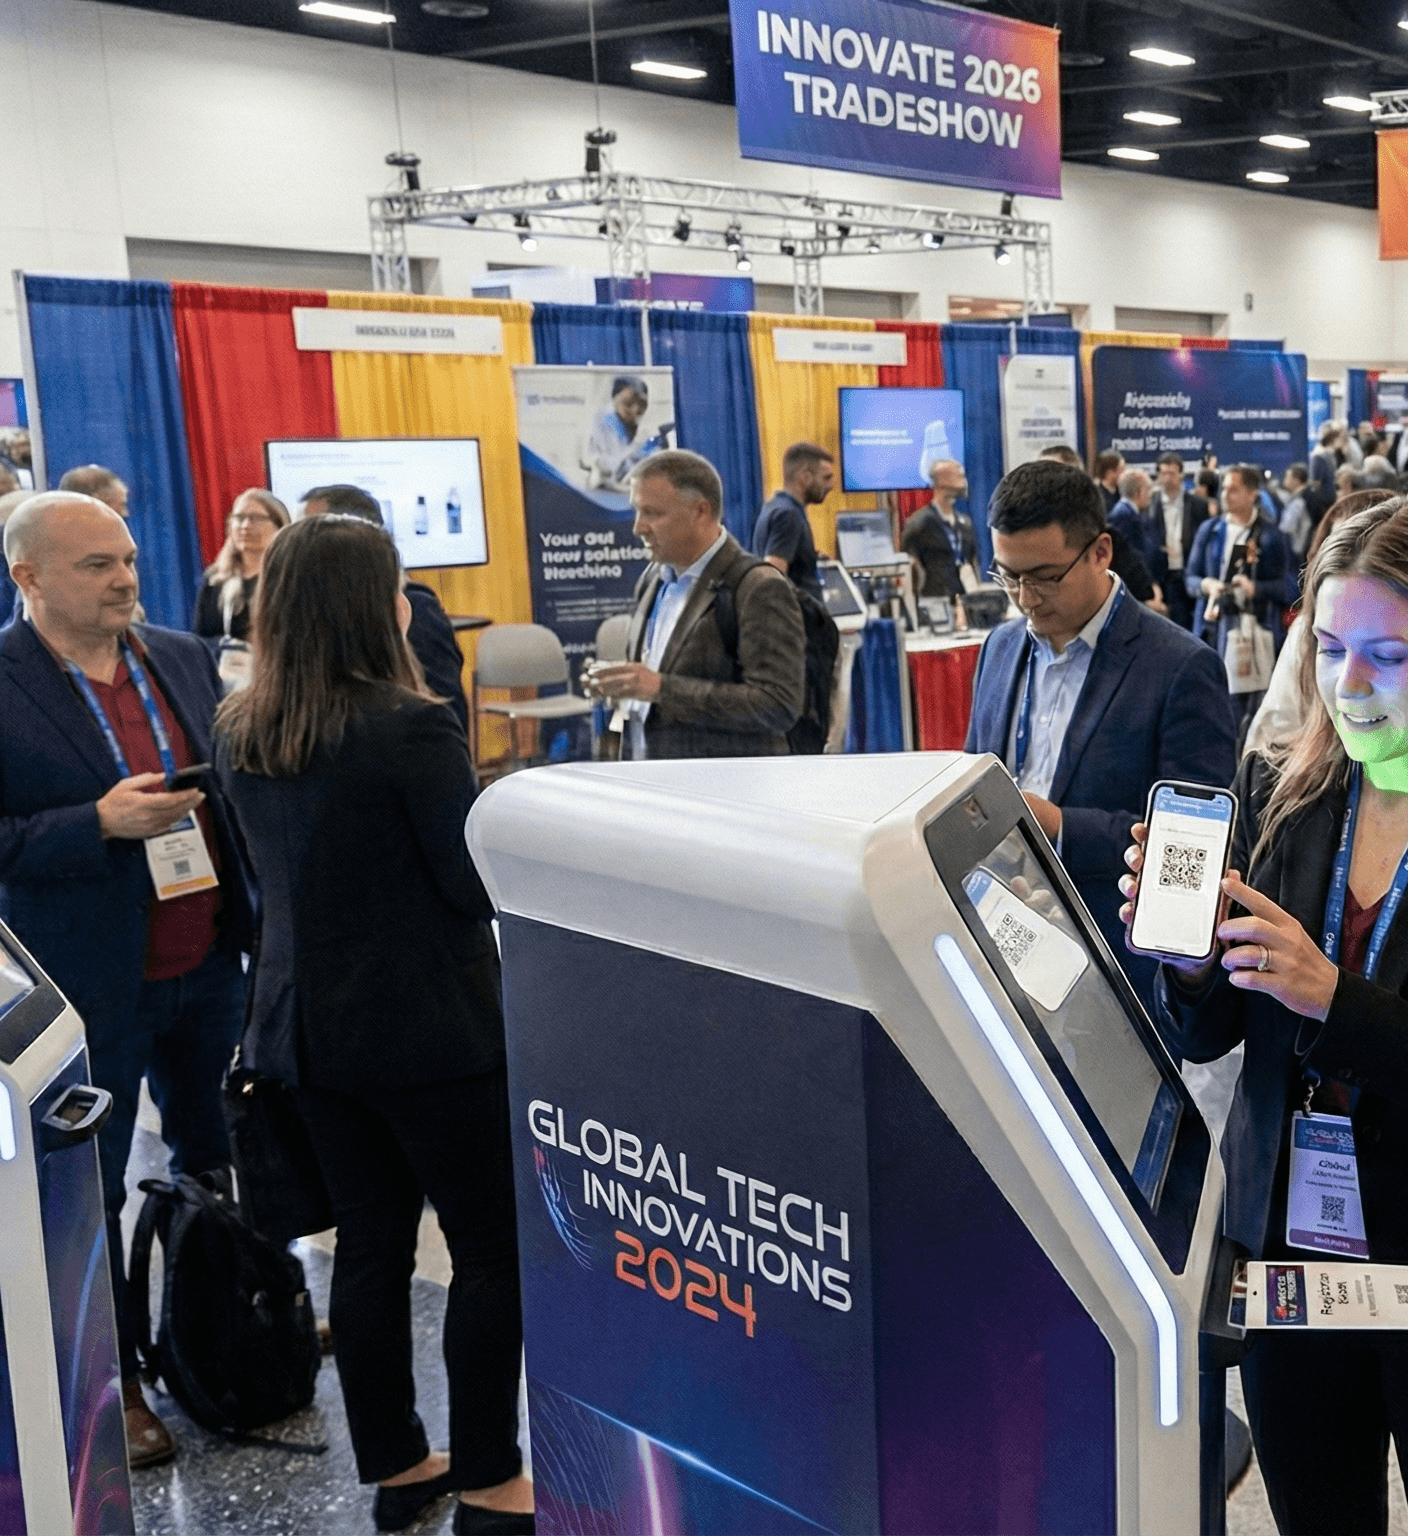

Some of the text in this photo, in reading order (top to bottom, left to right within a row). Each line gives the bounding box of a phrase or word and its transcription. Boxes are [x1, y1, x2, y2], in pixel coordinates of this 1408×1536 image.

[757, 10, 1043, 105] INNOVATE 2026
[784, 71, 1024, 149] TRADESHOW
[526, 1098, 851, 1263] GLOBAL TECH
[582, 1168, 853, 1314] INNOVATIONS
[614, 1229, 758, 1338] 2024
